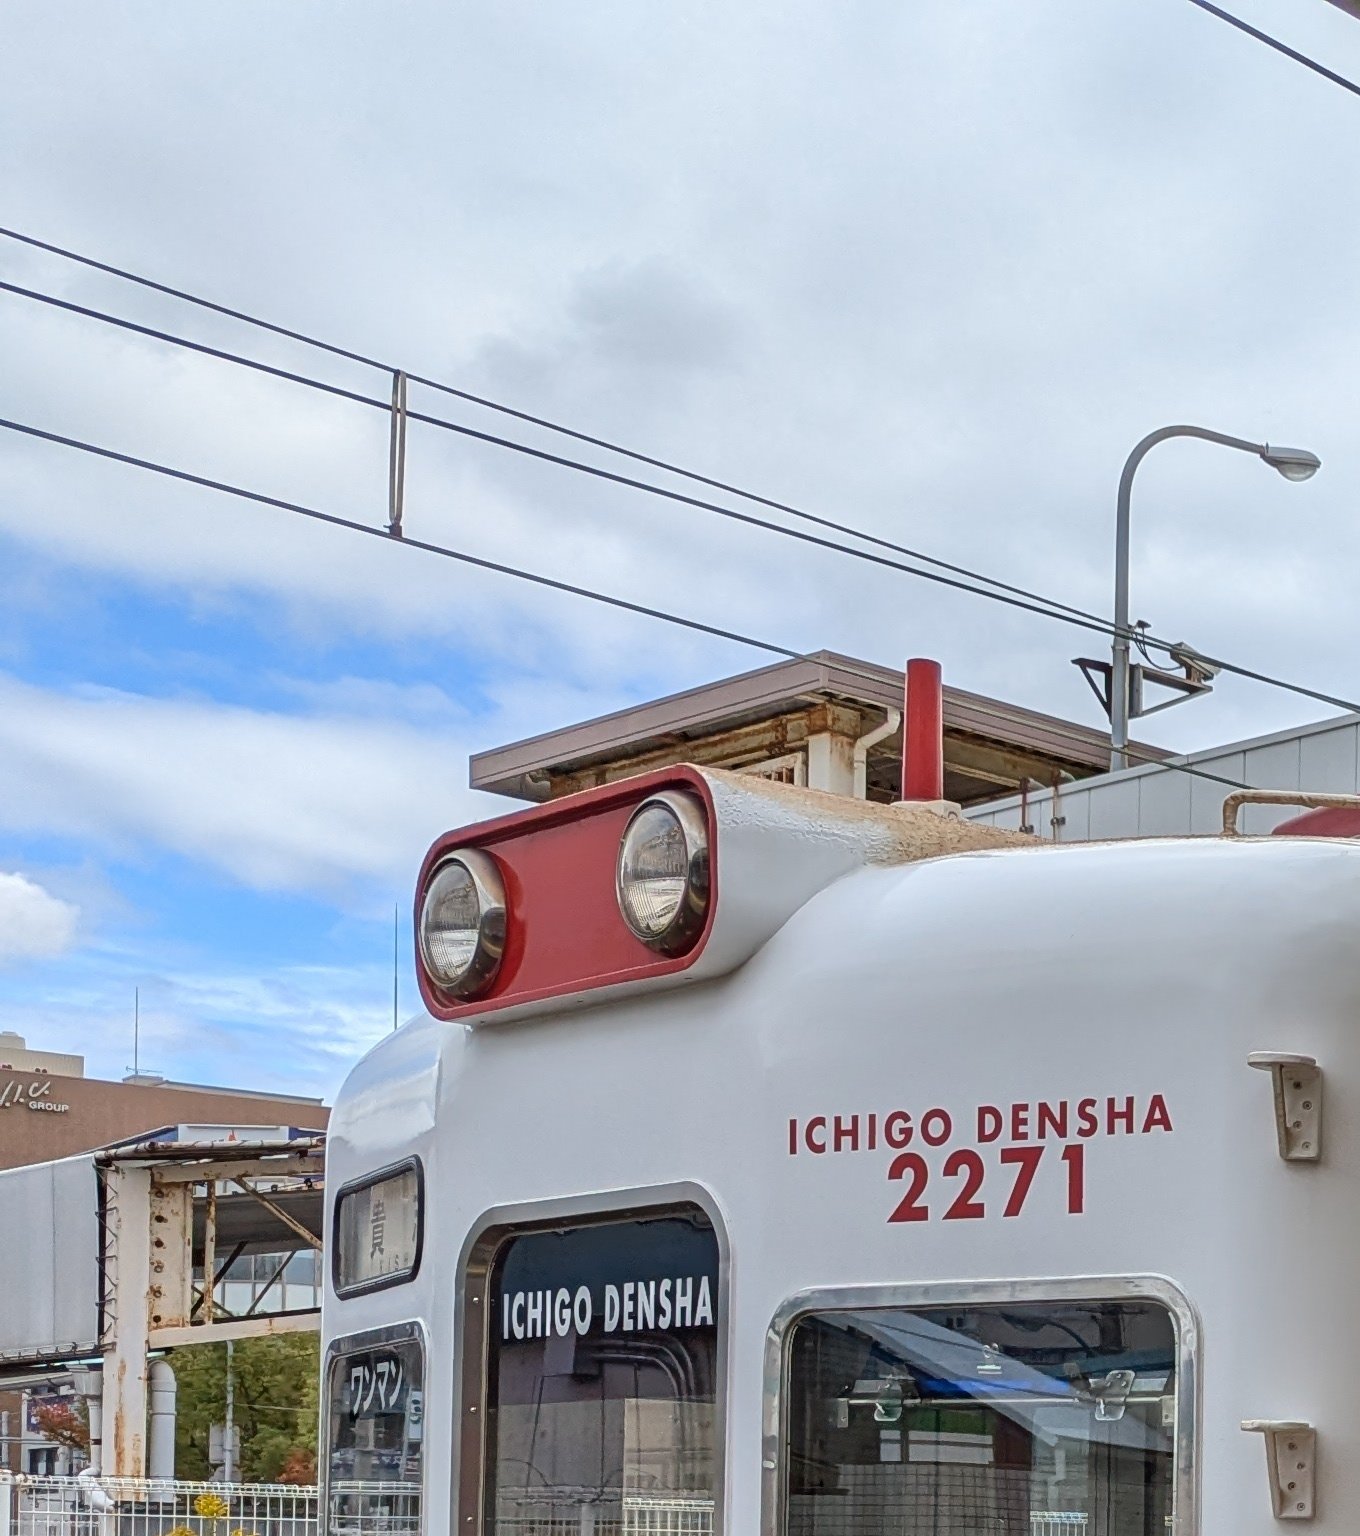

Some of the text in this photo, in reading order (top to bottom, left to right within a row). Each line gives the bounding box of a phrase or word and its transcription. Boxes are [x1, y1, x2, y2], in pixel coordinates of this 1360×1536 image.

[28, 1101, 70, 1113] GROUP
[788, 1093, 1174, 1155] ICHIGO DENSHA
[886, 1143, 1085, 1224] 2271
[503, 1275, 714, 1341] ICHIGO DENSHA
[349, 1359, 403, 1417] ワンマン
